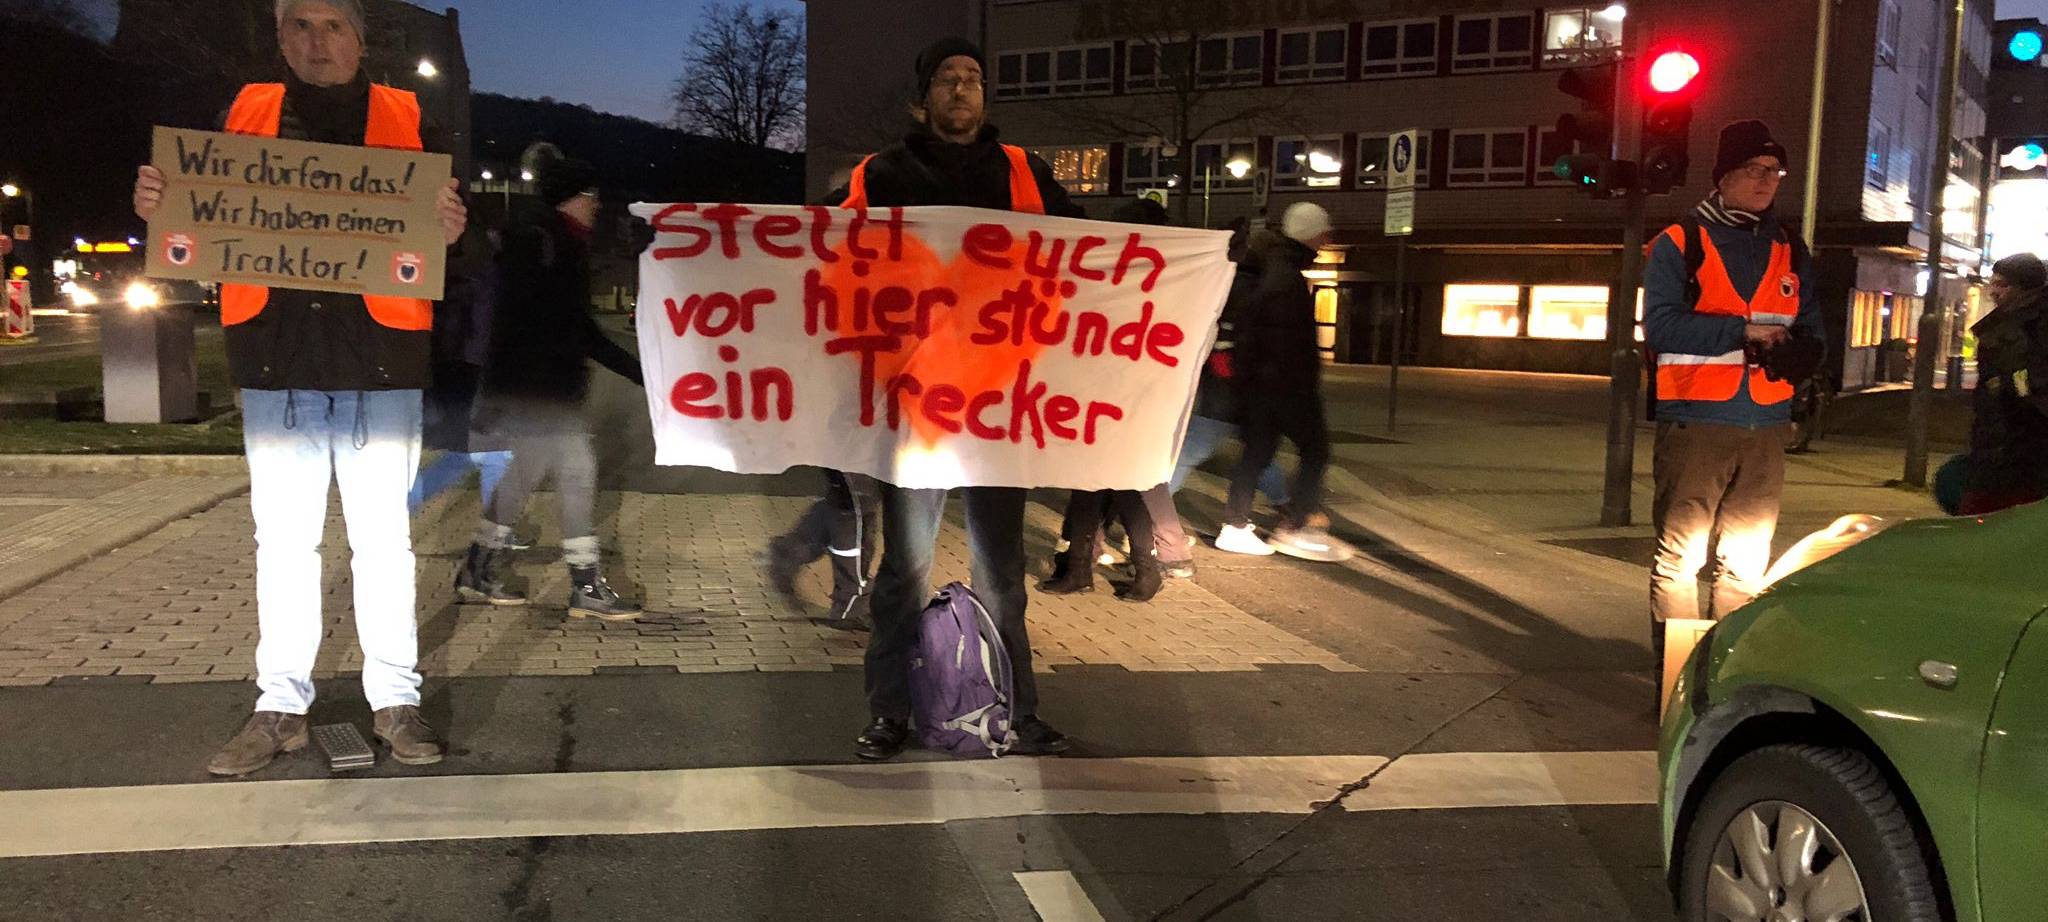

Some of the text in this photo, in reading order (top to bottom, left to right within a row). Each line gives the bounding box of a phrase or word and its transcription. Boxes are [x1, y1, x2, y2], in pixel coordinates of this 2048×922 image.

[177, 135, 416, 194] Wir dürfen das!
[190, 188, 405, 234] Wir haben einen
[962, 223, 1167, 292] euch
[663, 260, 1185, 368] vor hier stünde
[670, 335, 1123, 449] ein Trecker
